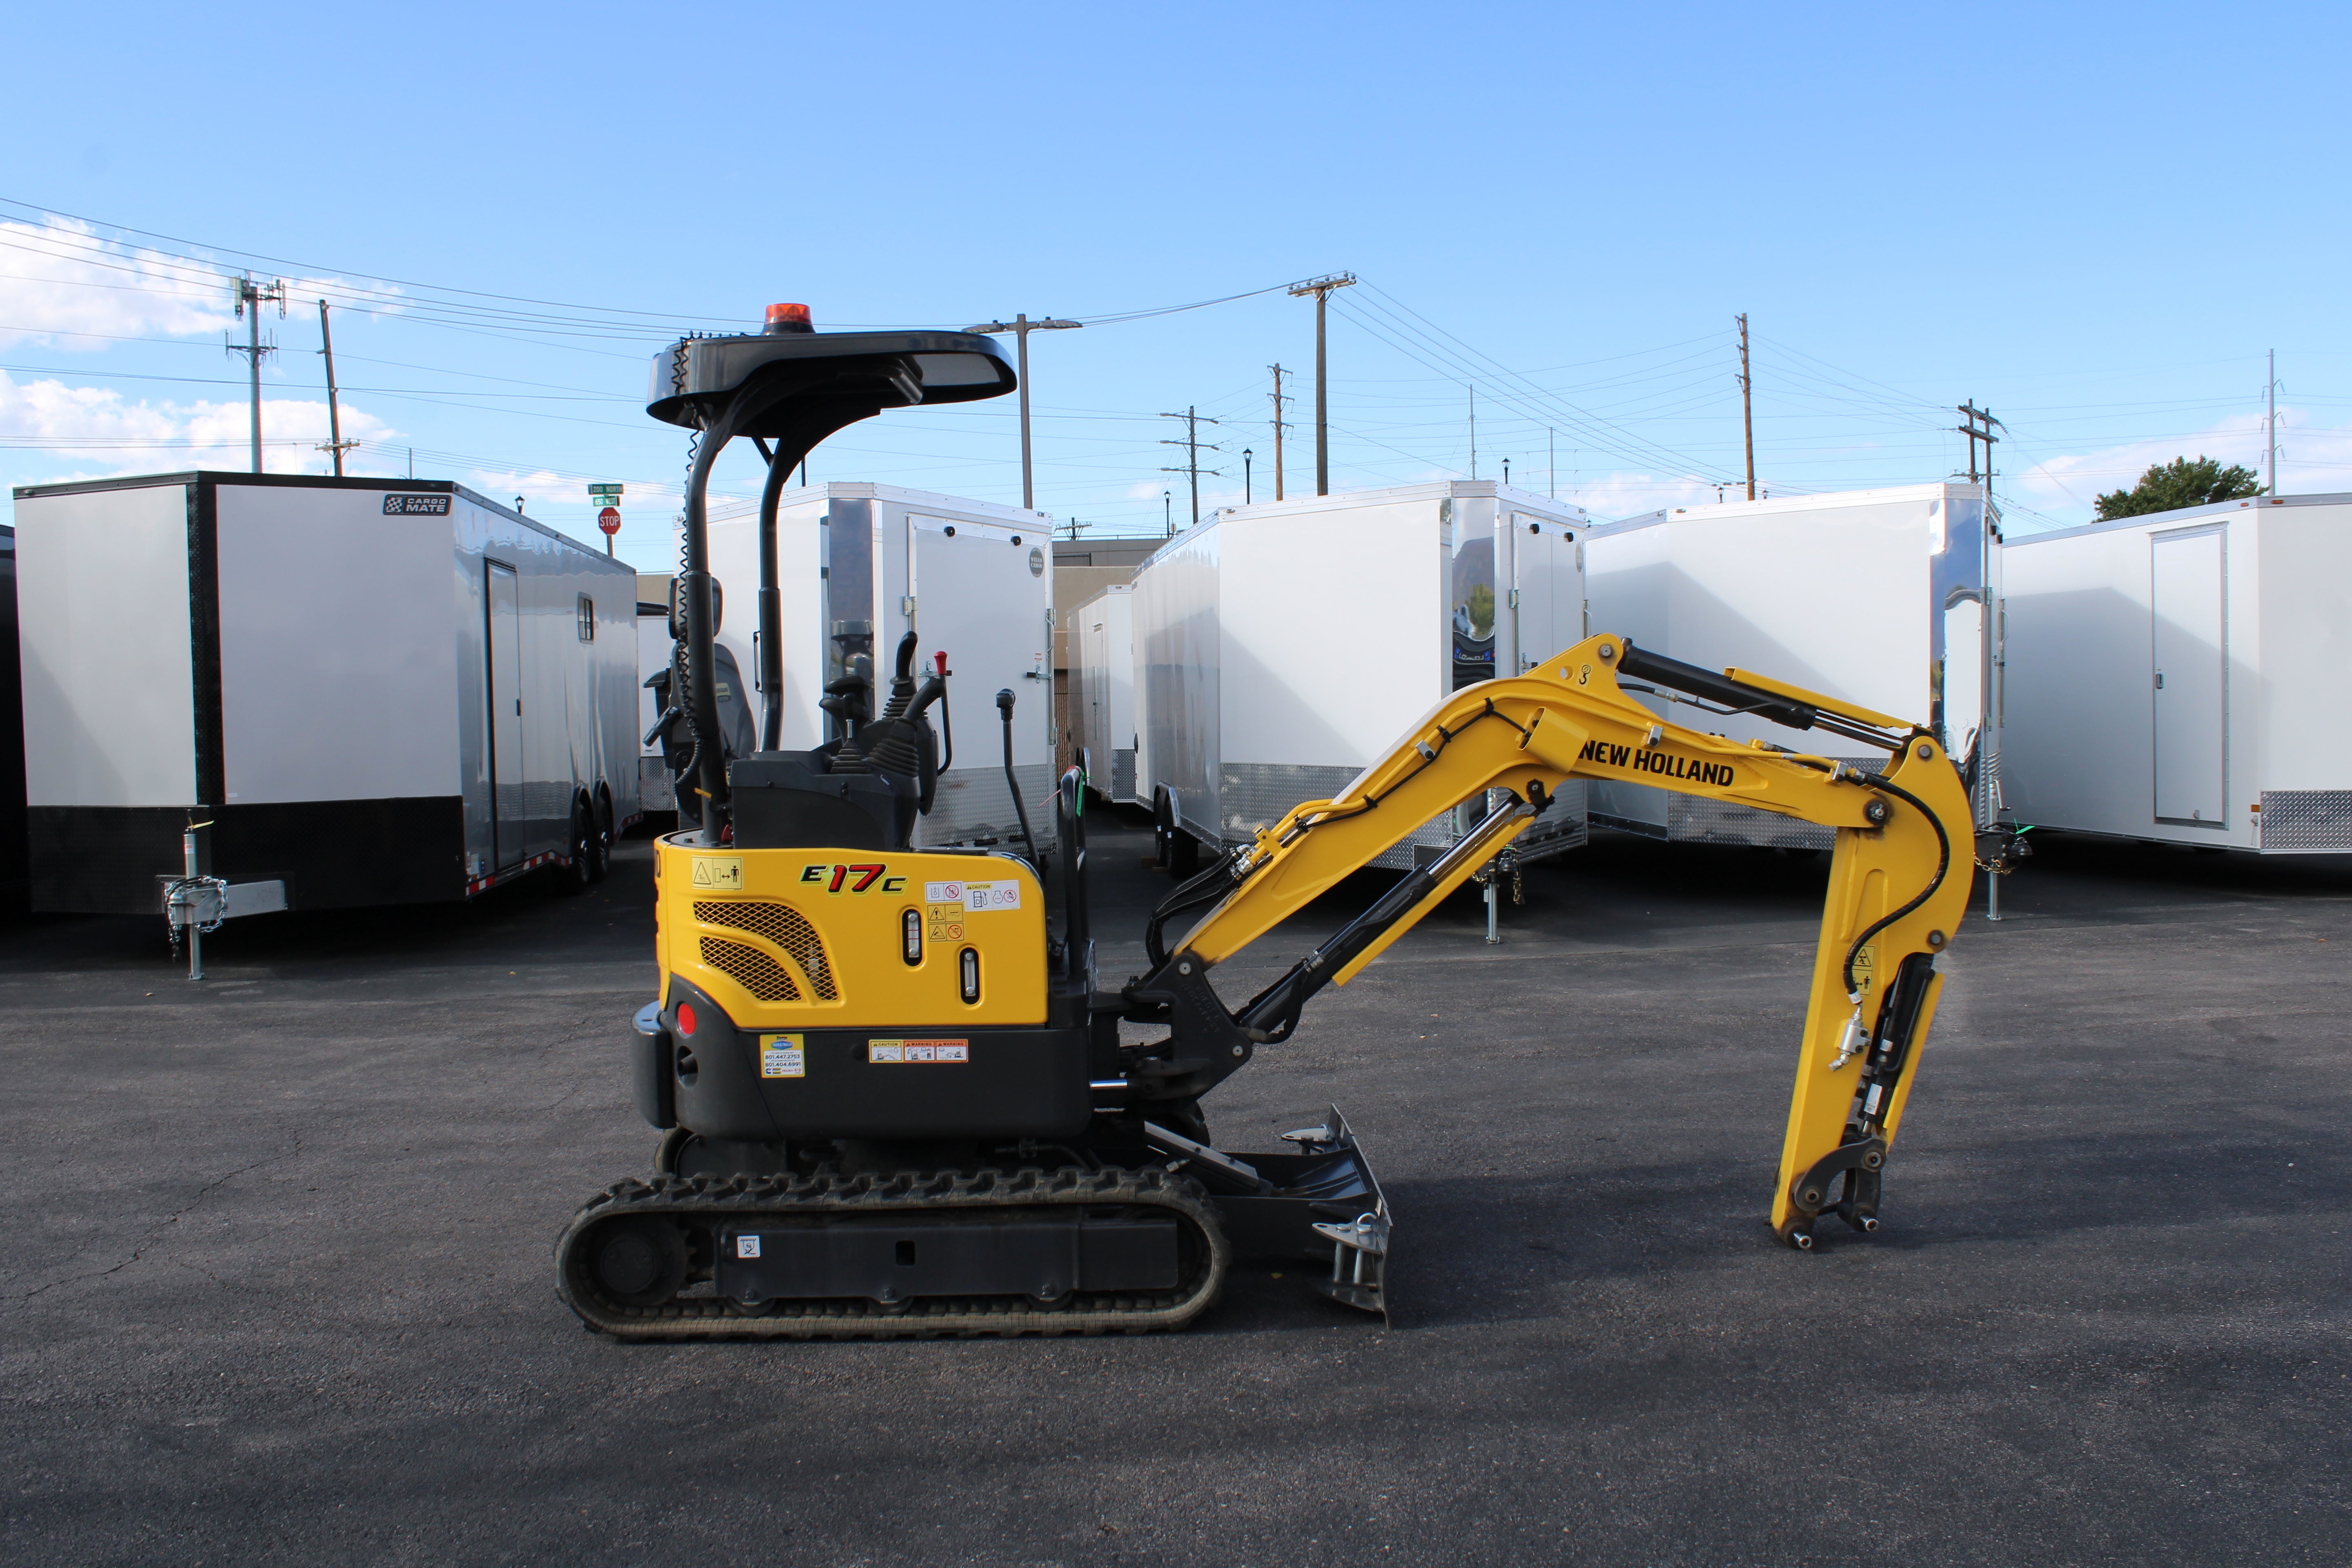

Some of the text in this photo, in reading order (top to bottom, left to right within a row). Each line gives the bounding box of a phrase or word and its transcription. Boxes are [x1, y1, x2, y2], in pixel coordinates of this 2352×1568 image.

[600, 516, 619, 527] STOP
[1578, 740, 1734, 786] NEW HOLLAND
